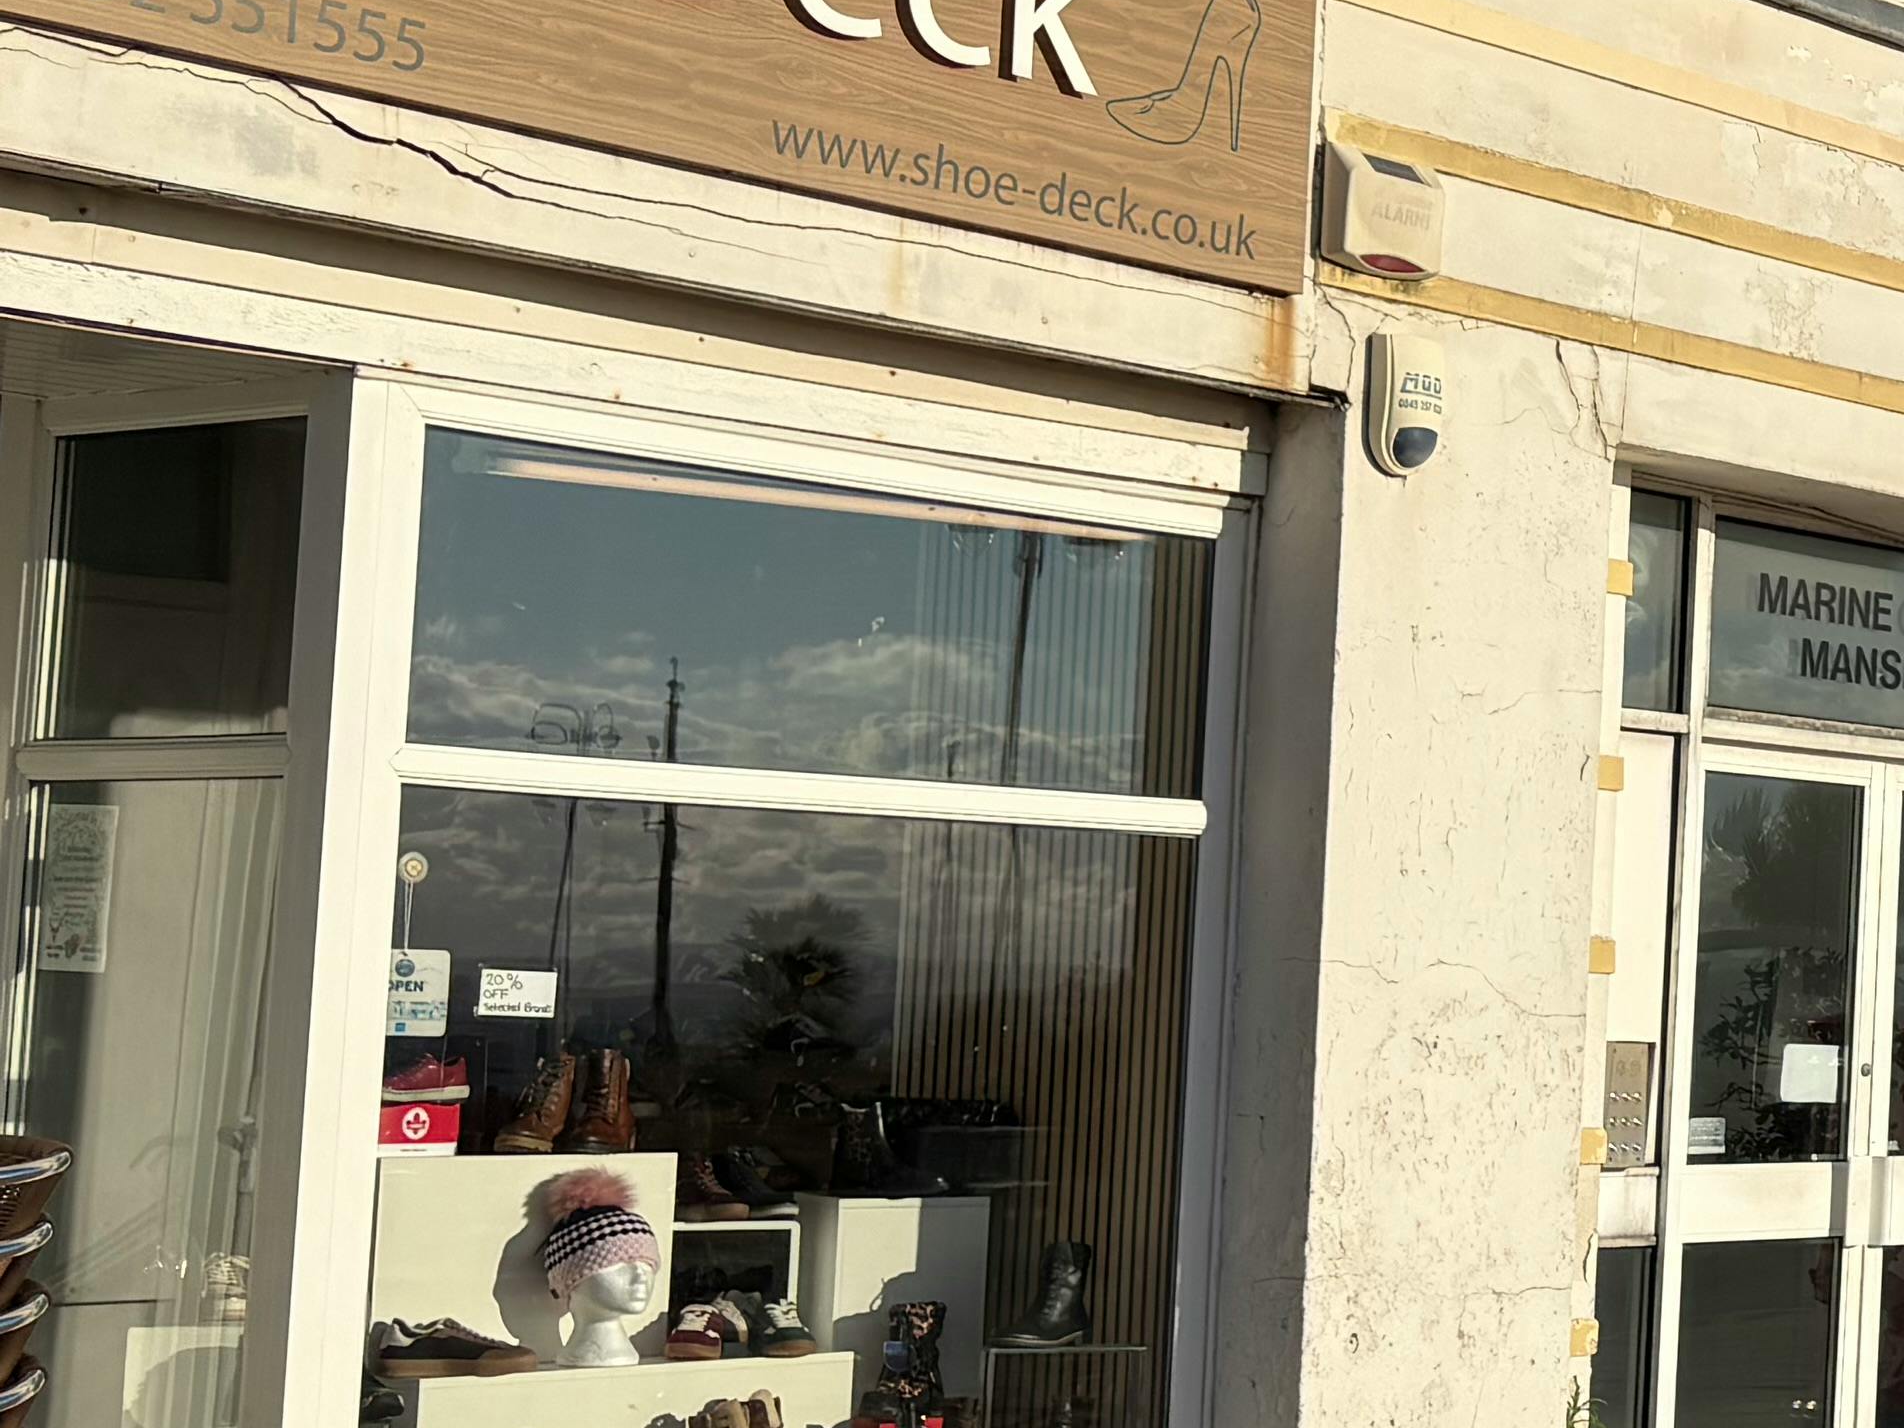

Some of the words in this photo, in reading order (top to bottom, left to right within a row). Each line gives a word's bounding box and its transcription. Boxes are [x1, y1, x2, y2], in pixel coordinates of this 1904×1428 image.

[772, 119, 1257, 261] www.shoe-deck.co.uk
[1757, 572, 1894, 633] MARINE
[483, 988, 509, 1000] OFF
